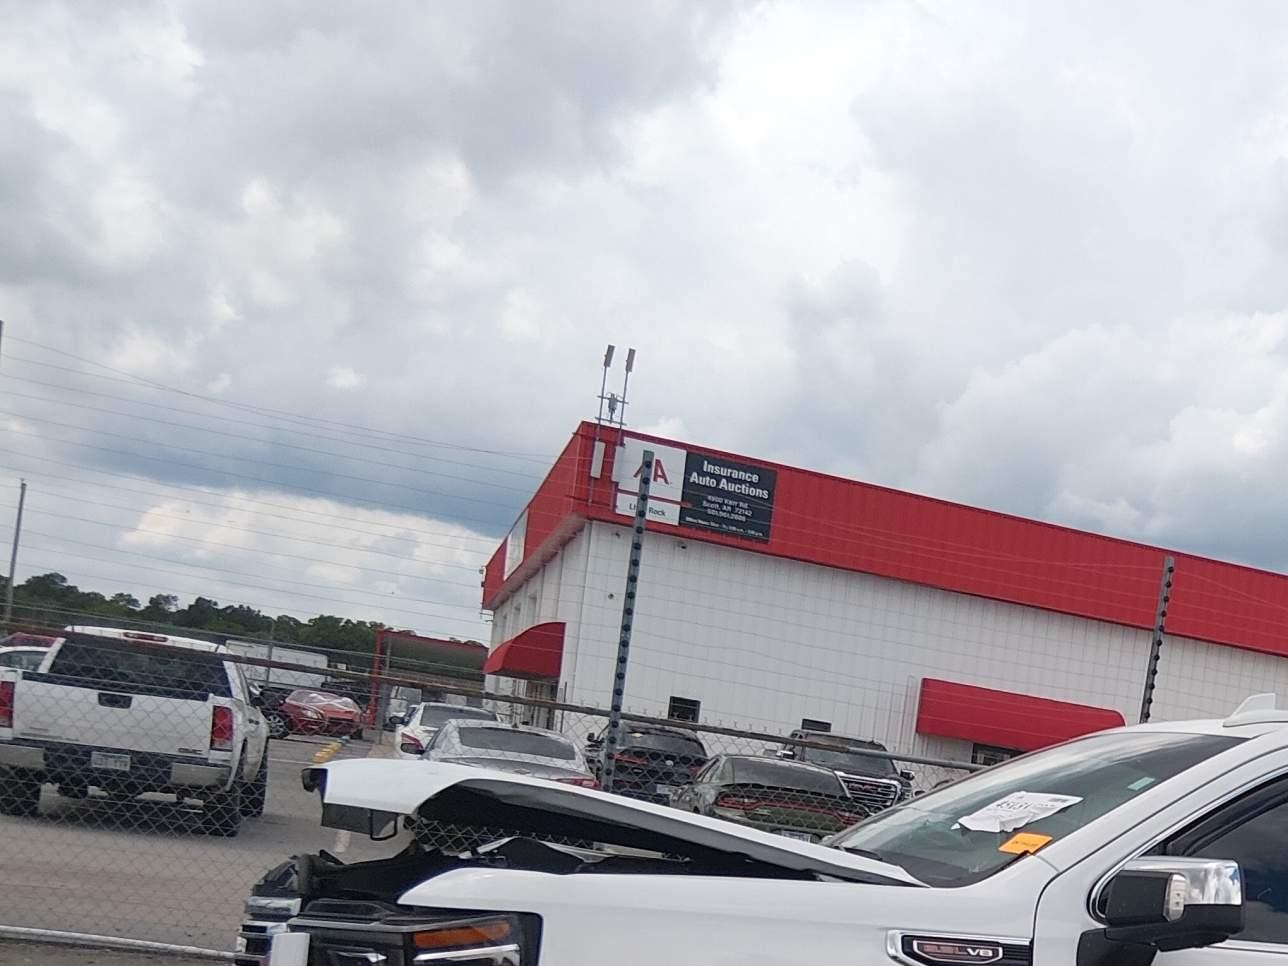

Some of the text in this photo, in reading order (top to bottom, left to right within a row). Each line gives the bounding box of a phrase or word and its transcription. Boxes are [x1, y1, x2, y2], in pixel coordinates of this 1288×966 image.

[703, 460, 759, 483] Insurance
[690, 472, 769, 499] Auto Auctions
[967, 948, 993, 957] V8
